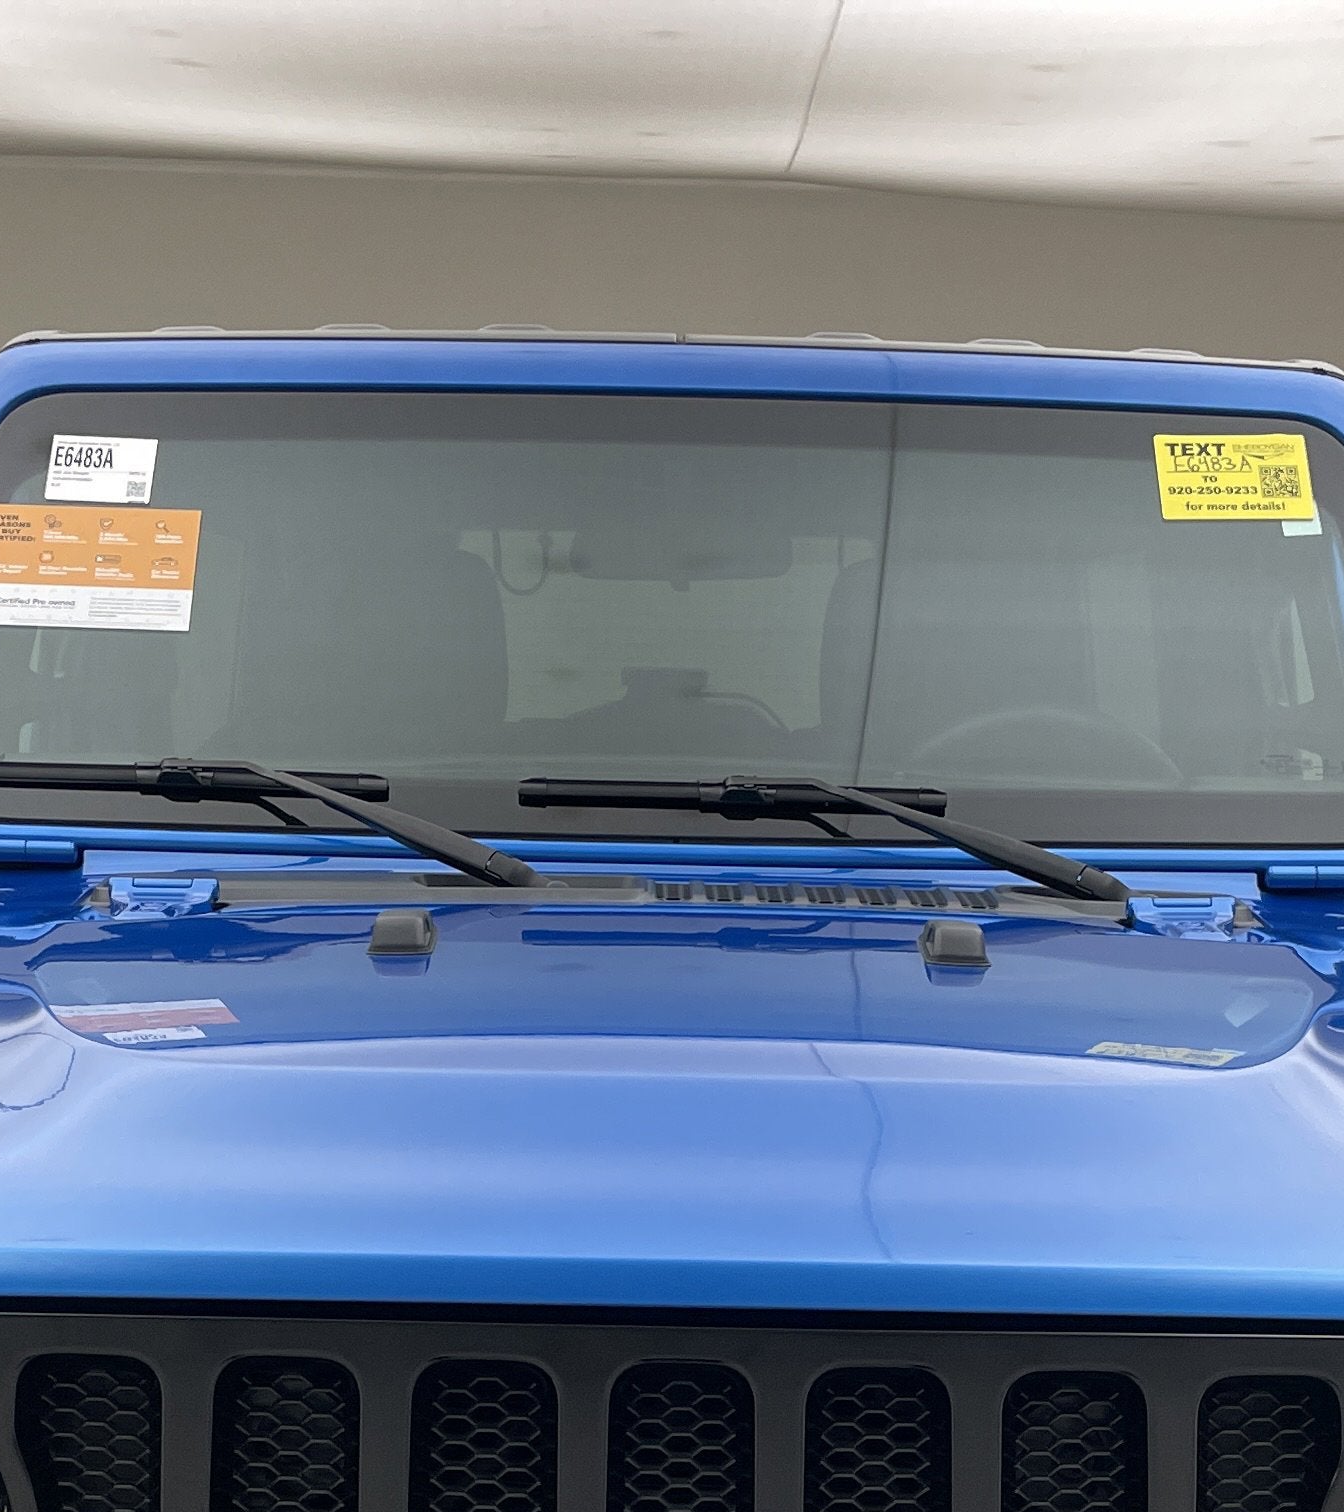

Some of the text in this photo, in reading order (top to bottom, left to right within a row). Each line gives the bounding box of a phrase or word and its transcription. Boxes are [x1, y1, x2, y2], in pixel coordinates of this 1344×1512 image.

[1165, 443, 1225, 456] TEXT
[54, 446, 113, 469] E6483A
[1173, 455, 1252, 473] E6483A
[1201, 475, 1218, 483] TO
[1168, 486, 1258, 495] 920-250-9233
[1185, 501, 1286, 511] for more details!
